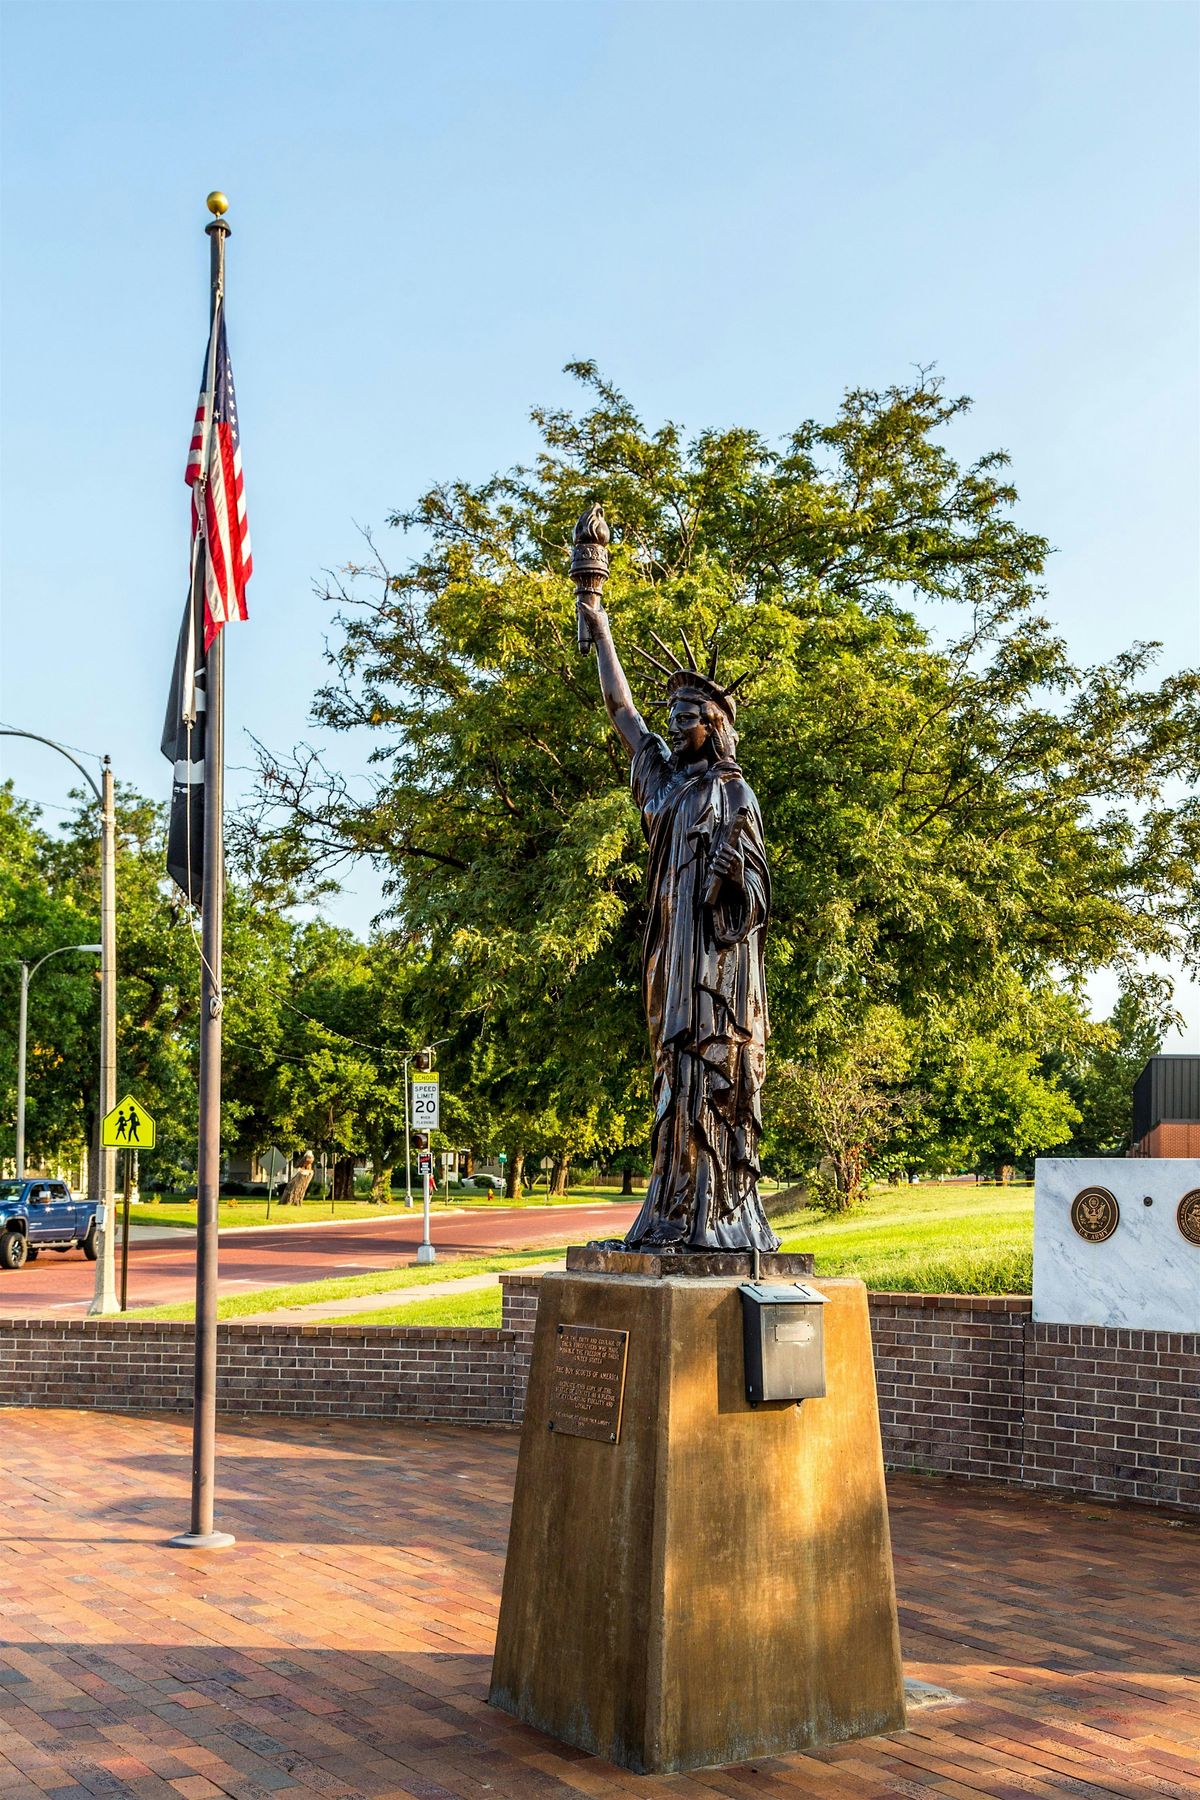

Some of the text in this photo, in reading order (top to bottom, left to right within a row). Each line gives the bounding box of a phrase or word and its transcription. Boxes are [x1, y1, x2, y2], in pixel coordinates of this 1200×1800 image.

[416, 1101, 436, 1113] 20
[1091, 1229, 1108, 1239] ARMY
[576, 1369, 592, 1378] SCOUTS
[600, 1373, 619, 1381] AMERICA
